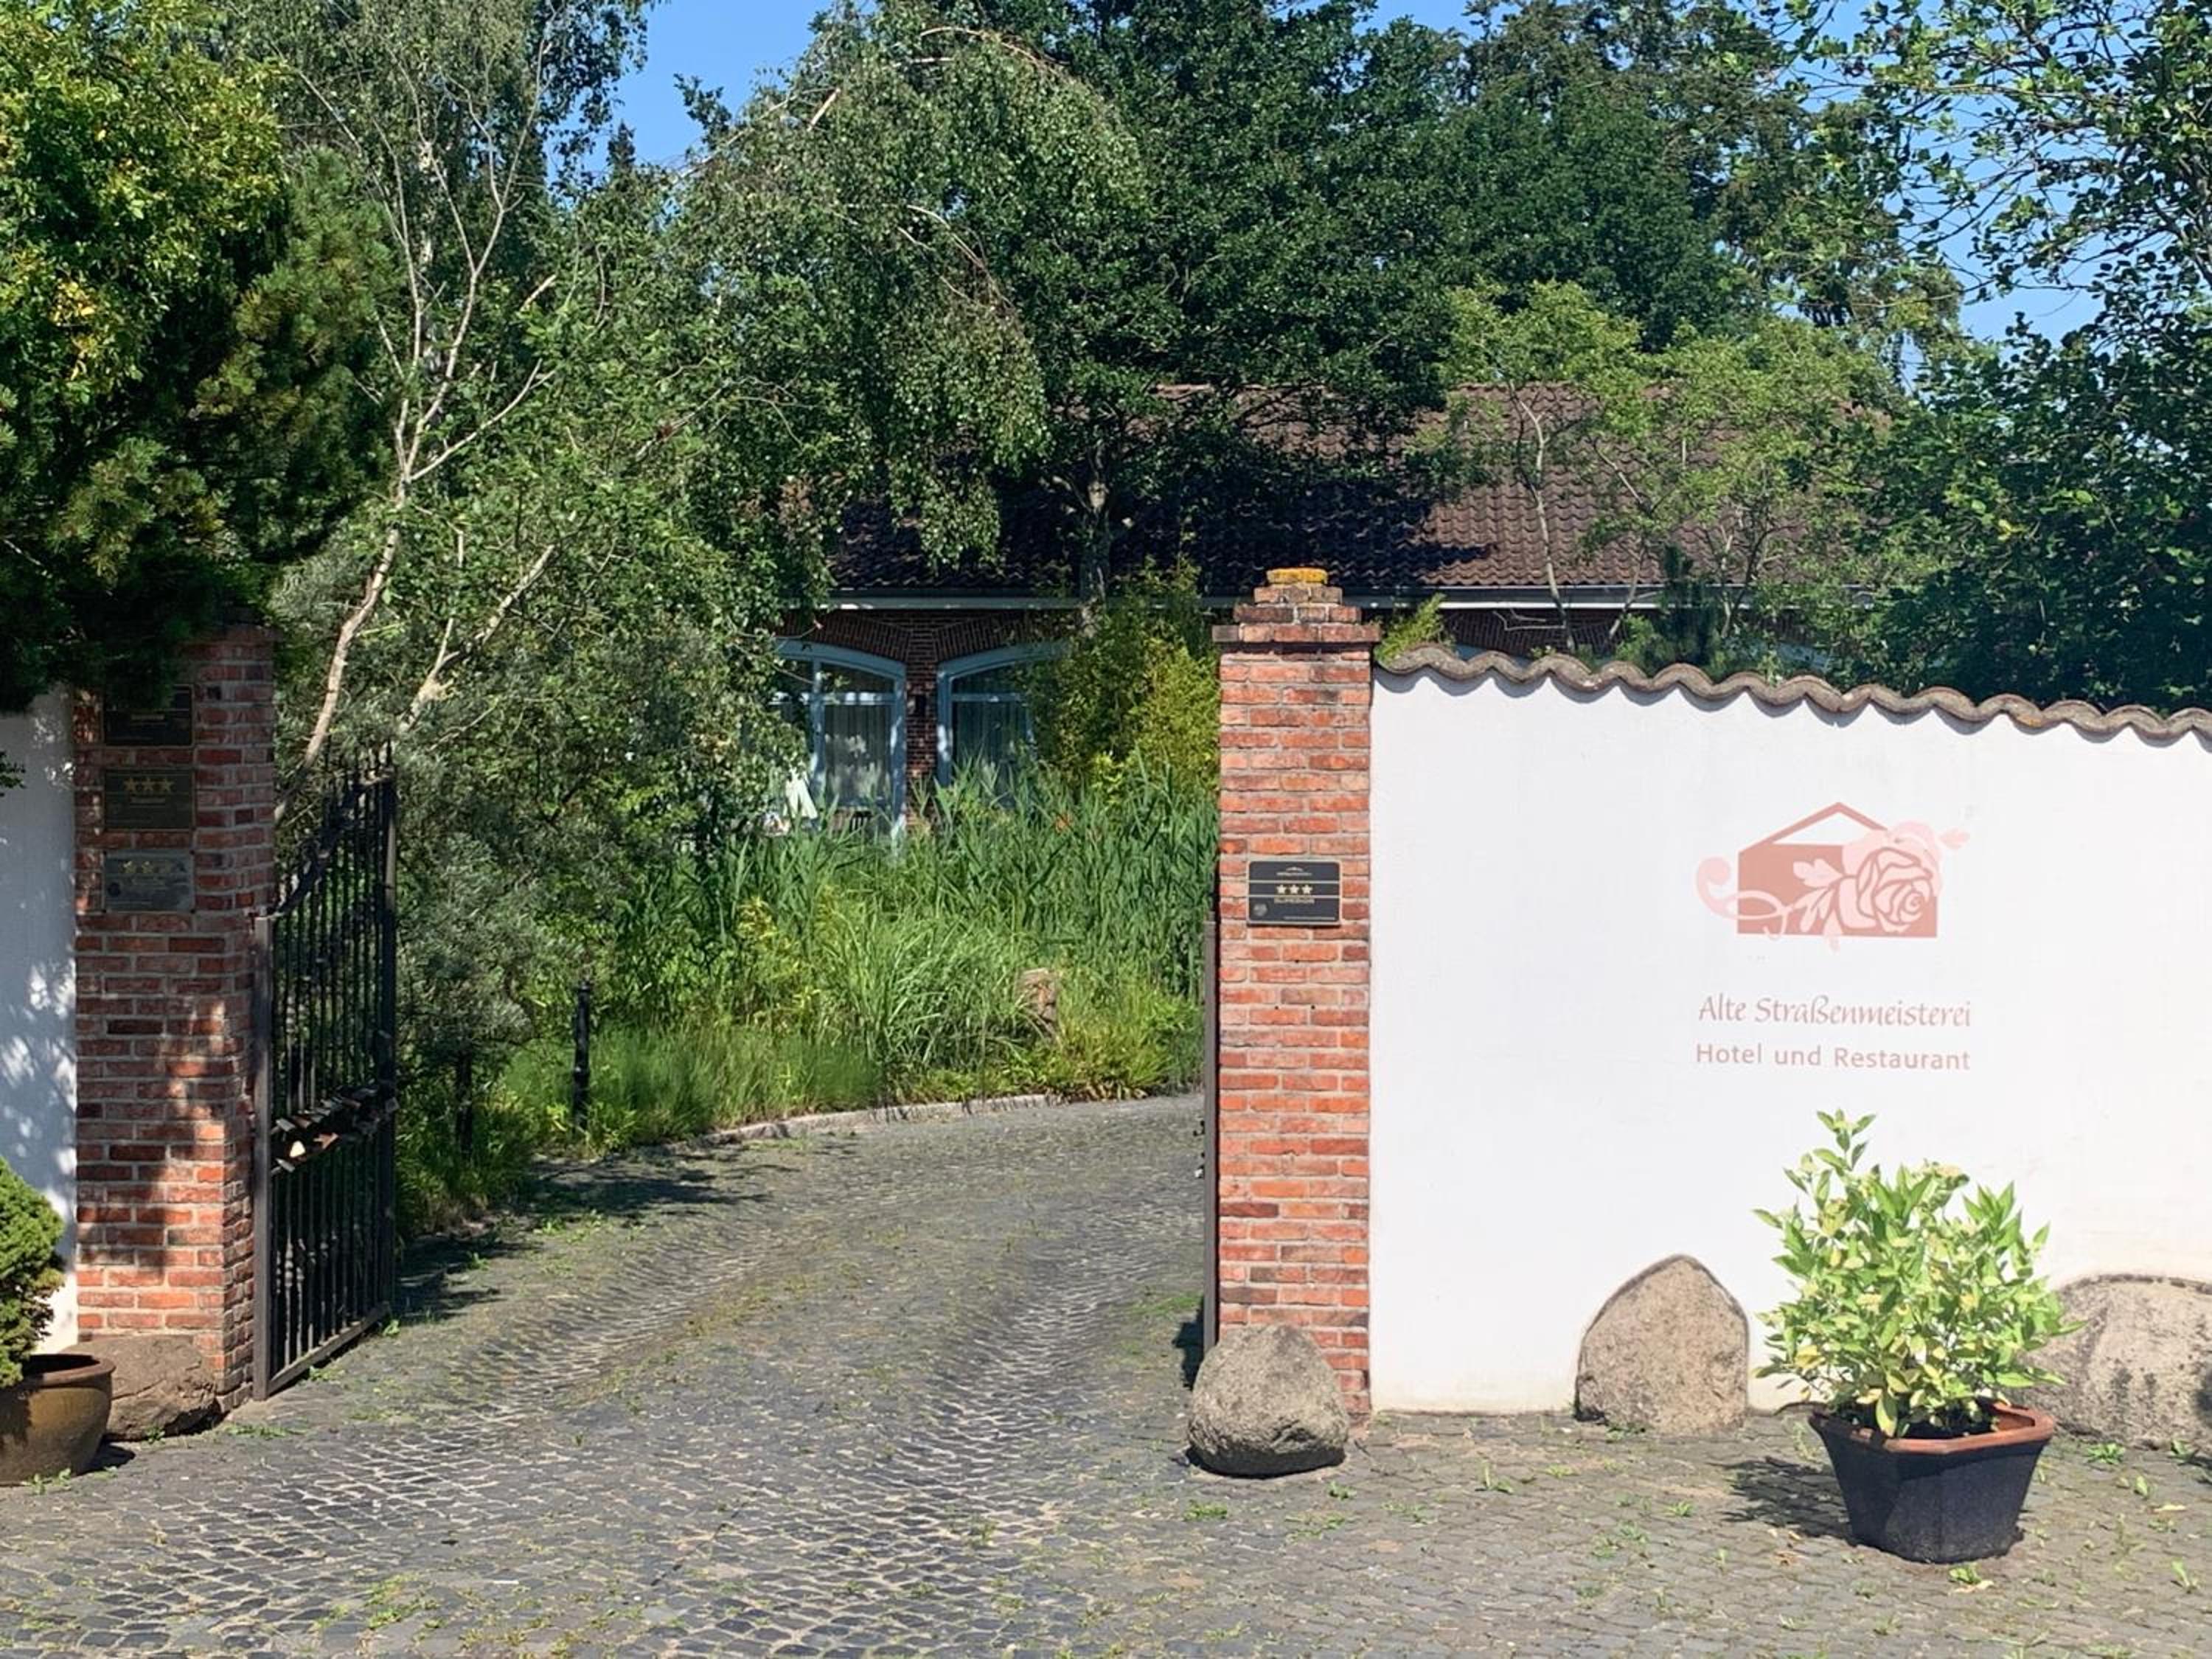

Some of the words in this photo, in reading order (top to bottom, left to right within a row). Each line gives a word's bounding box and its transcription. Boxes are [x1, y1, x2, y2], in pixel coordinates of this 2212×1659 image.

[1699, 993, 1747, 1021] Alte
[1754, 994, 1971, 1027] Straßenmeisterei
[1696, 1043, 1763, 1064] Hotel
[1774, 1045, 1821, 1066] und
[1834, 1046, 1971, 1071] Restaurant
